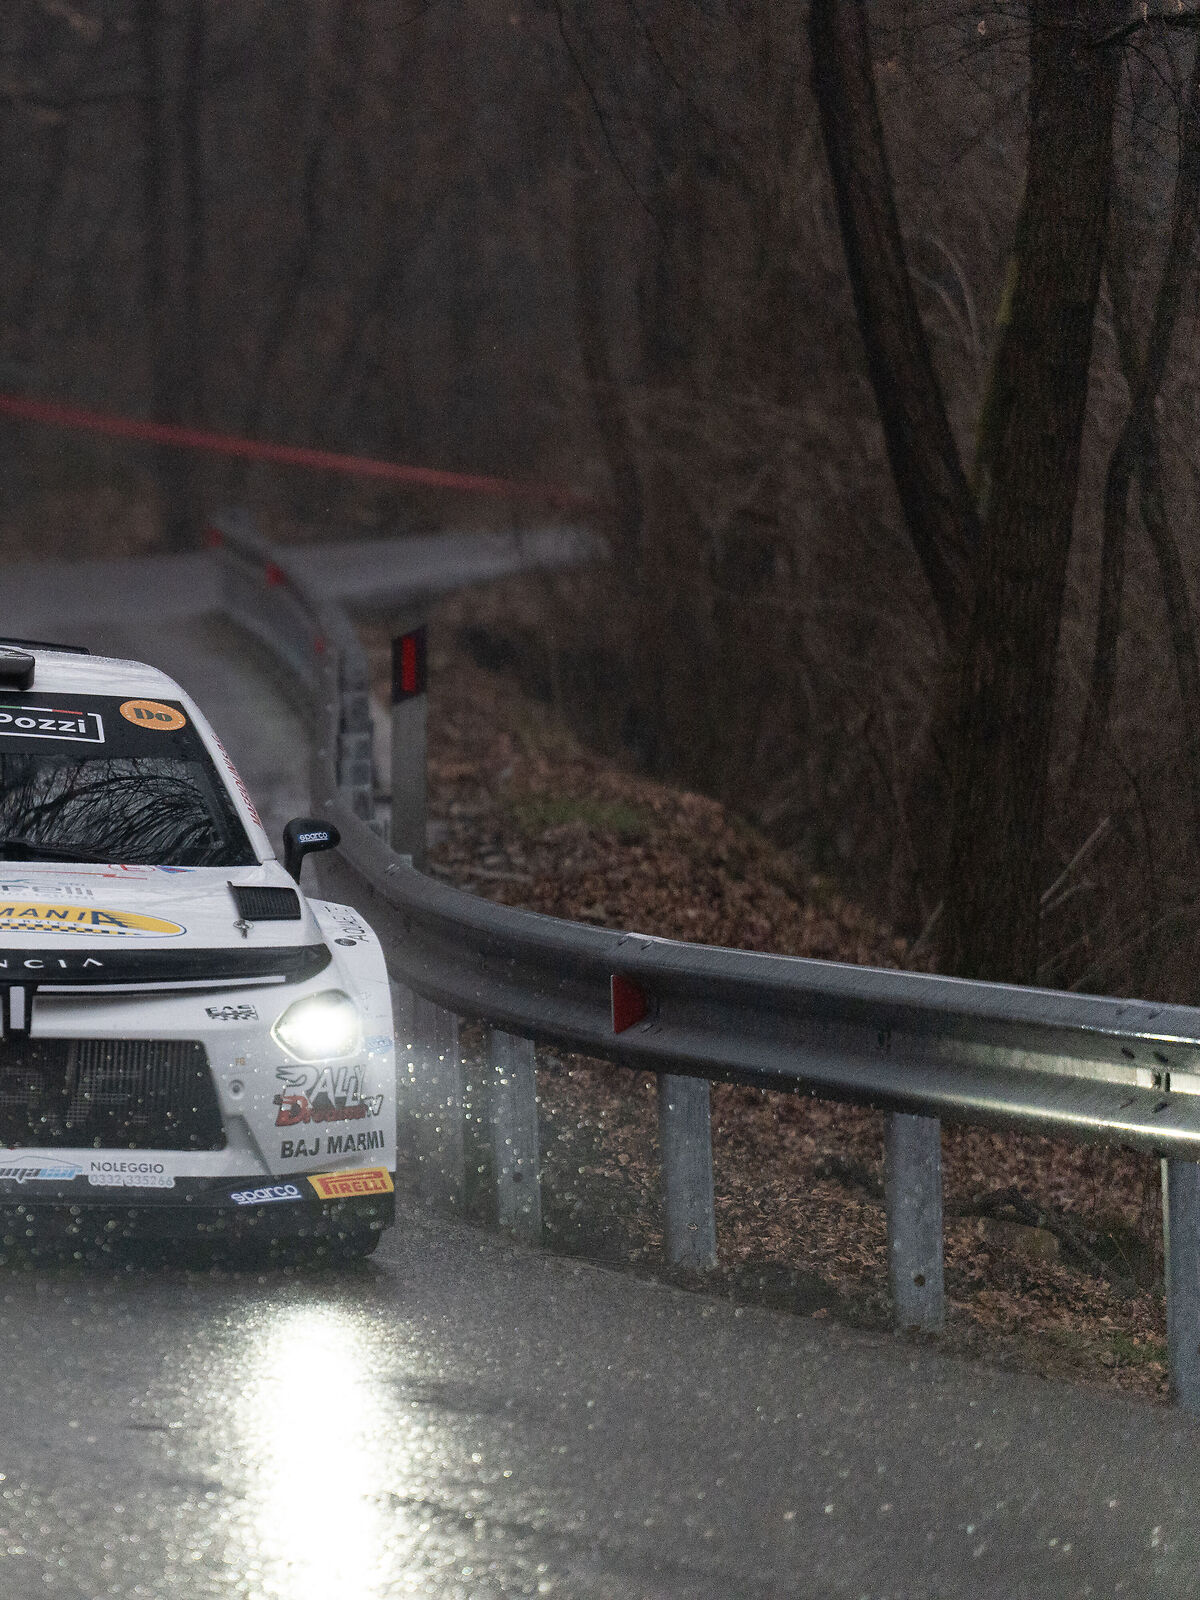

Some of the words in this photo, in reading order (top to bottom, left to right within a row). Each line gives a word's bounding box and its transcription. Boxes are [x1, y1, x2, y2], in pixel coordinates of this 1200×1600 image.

[300, 831, 328, 842] sparco
[281, 1138, 320, 1159] BAJ
[326, 1130, 385, 1155] MARMI
[91, 1162, 164, 1174] NOLEGGIO
[317, 1171, 388, 1195] PIRELLI
[231, 1184, 299, 1204] sparco
